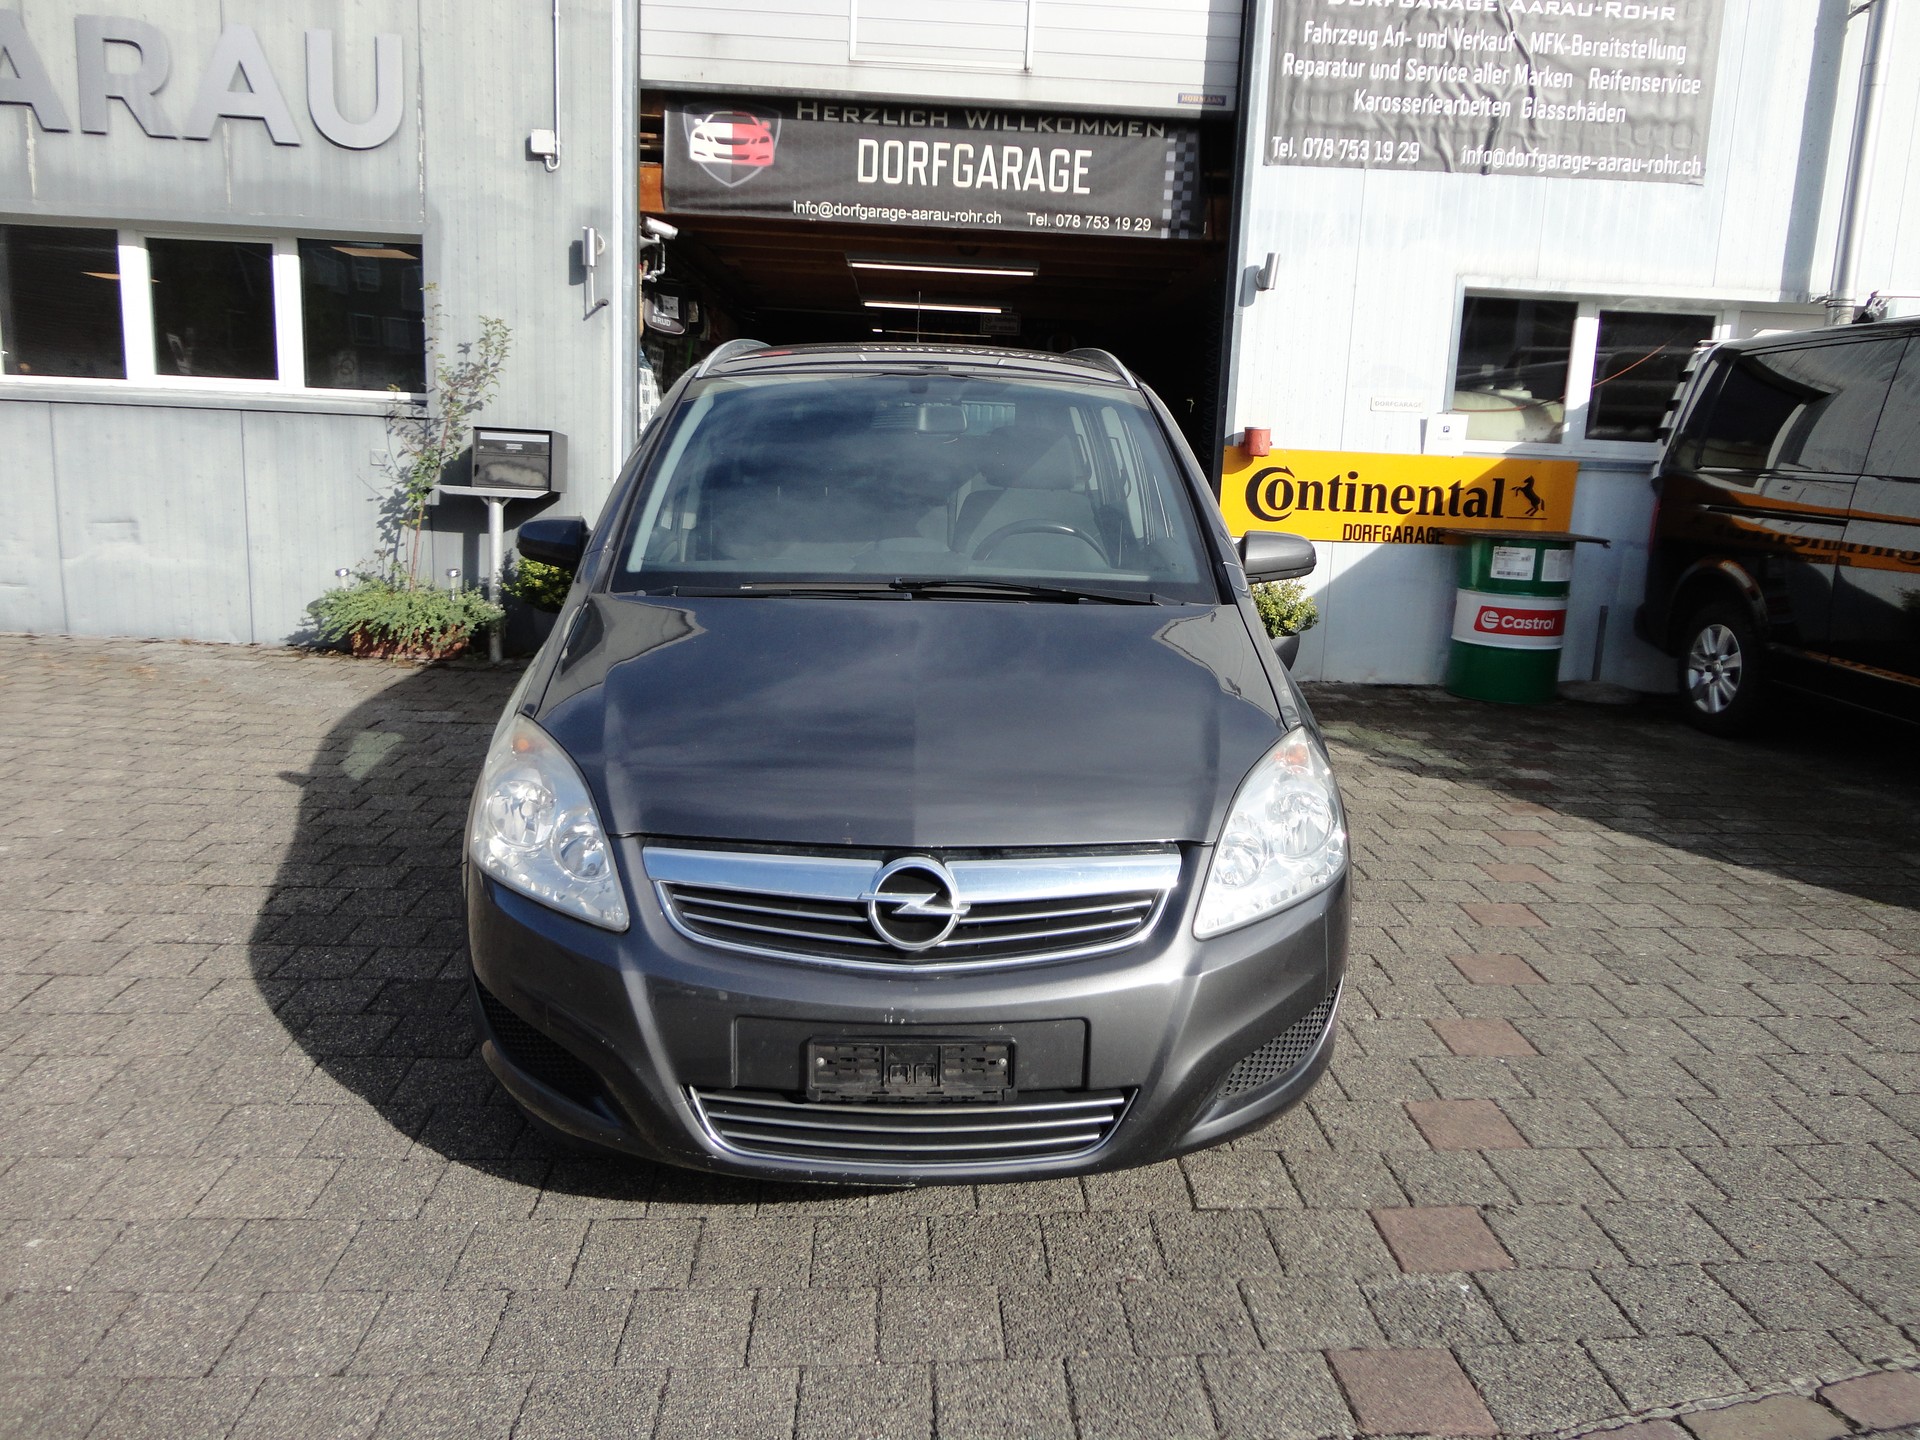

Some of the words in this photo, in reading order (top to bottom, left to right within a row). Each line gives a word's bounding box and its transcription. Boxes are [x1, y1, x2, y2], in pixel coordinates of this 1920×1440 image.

[1326, 0, 1499, 12] ORFGARAGE
[1303, 20, 1380, 51] Fahrzeug
[1382, 25, 1412, 48] An-
[1417, 28, 1448, 49] und
[1453, 28, 1516, 52] Verkauf
[1529, 32, 1687, 65] MFK-Bereitstellung
[1282, 52, 1366, 81] Reparatur
[1369, 58, 1401, 80] und
[1405, 58, 1468, 83] Service
[1473, 62, 1510, 86] aller
[1513, 63, 1573, 89] Marken
[1589, 67, 1701, 94] Reifenservice
[797, 101, 949, 128] HERZLICH
[964, 110, 1166, 138] WILLKOMMEN
[1353, 89, 1511, 118] Karosseriearbeiten
[1520, 97, 1627, 123] Glasschäden
[1271, 136, 1298, 158] Tel.
[1303, 137, 1334, 159] 078
[1339, 139, 1370, 161] 753
[1374, 140, 1393, 162] 19
[1398, 141, 1420, 163] 29
[1460, 145, 1701, 175] info@dorfgarage-aarau-rohr.ch
[857, 138, 1093, 195] DORFGARAGE
[793, 200, 1002, 225] Info@dorfgarage-aarau-rohr.ch
[1027, 212, 1052, 227] Tel.
[1055, 213, 1081, 228] 078
[1085, 215, 1110, 230] 753
[1115, 217, 1131, 231] 19
[1134, 217, 1152, 232] 29
[1374, 400, 1422, 408] DORFGARAGE
[1245, 465, 1506, 522] Continental
[1342, 523, 1446, 545] DORFGARAGE
[1501, 615, 1555, 630] Castrol
